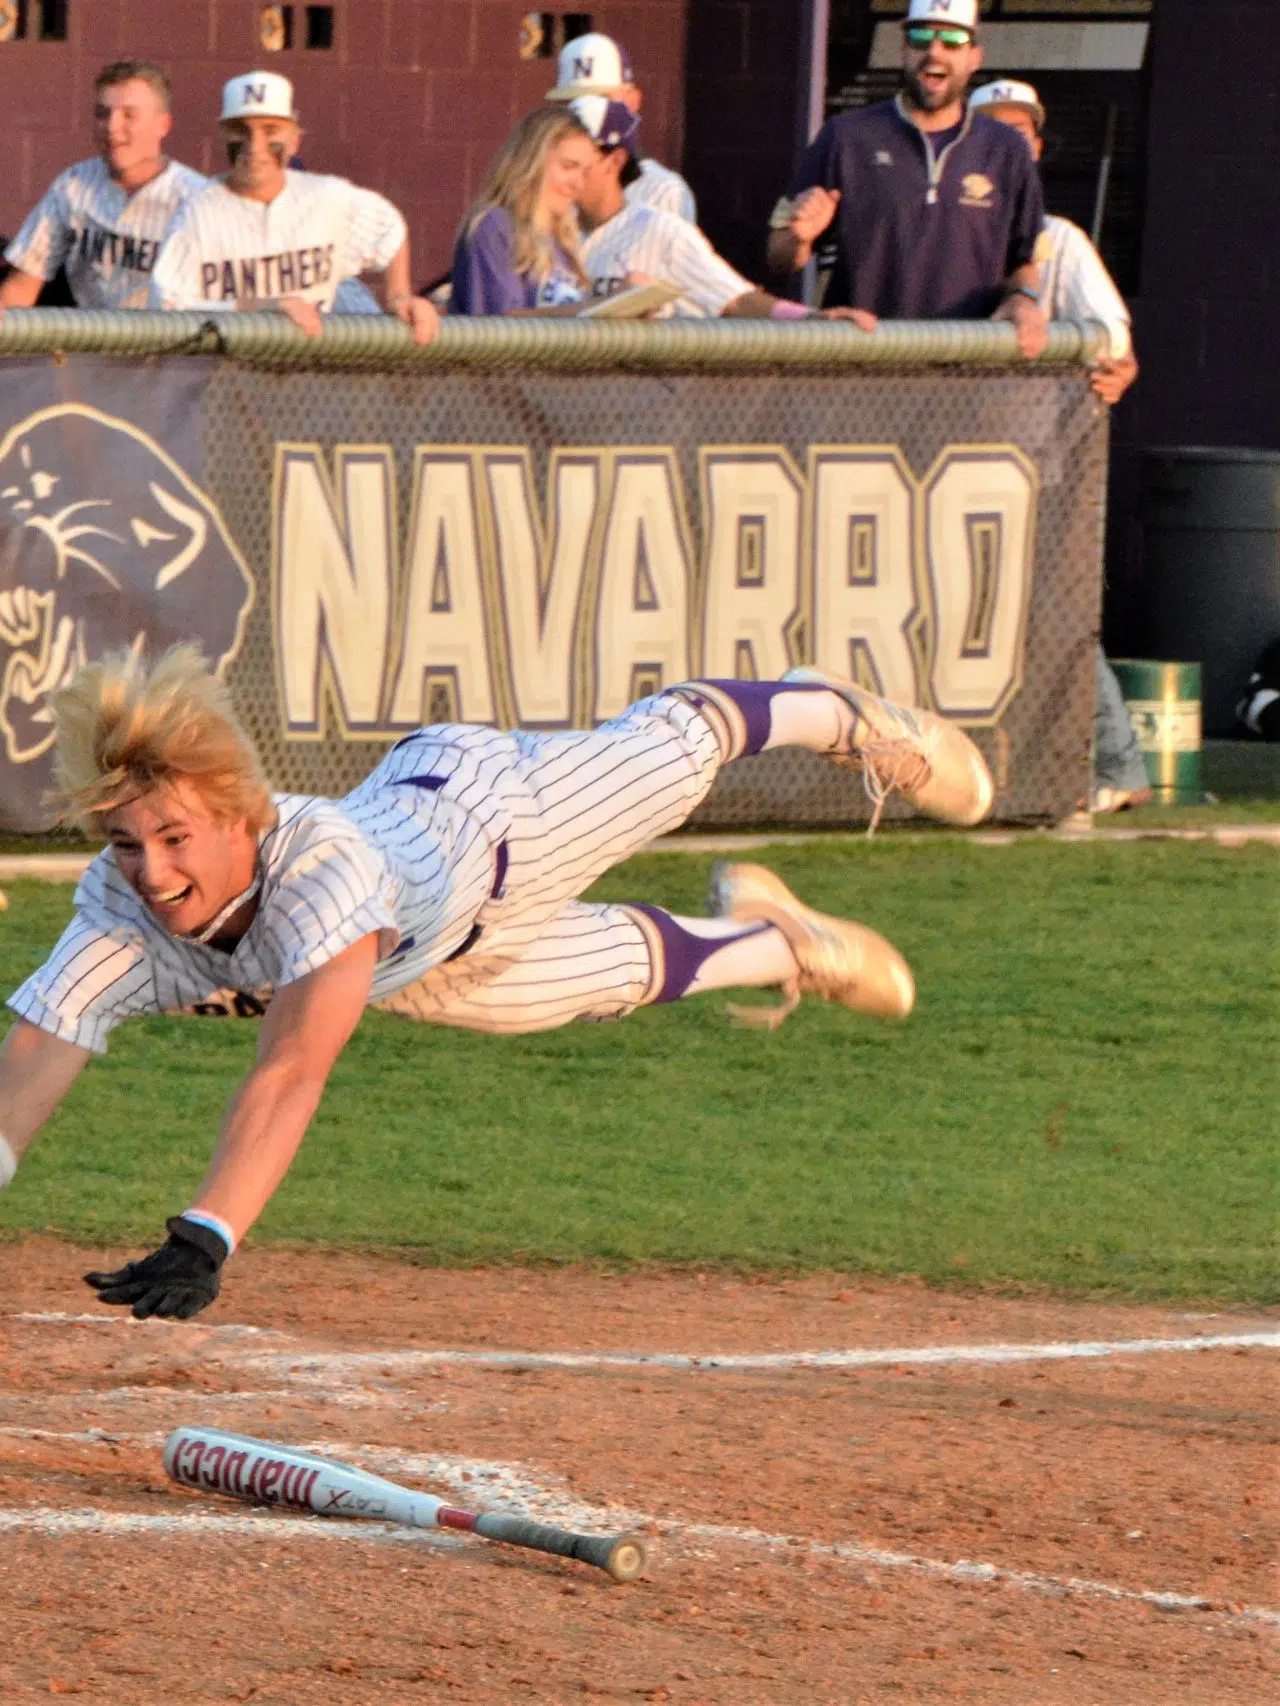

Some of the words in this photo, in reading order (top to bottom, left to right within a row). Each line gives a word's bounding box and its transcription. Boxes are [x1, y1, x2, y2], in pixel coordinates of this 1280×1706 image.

[244, 83, 266, 104] N
[572, 57, 593, 79] N
[202, 243, 334, 300] PANTHERS
[272, 442, 1039, 741] NAVARRO
[173, 1437, 319, 1509] marucci
